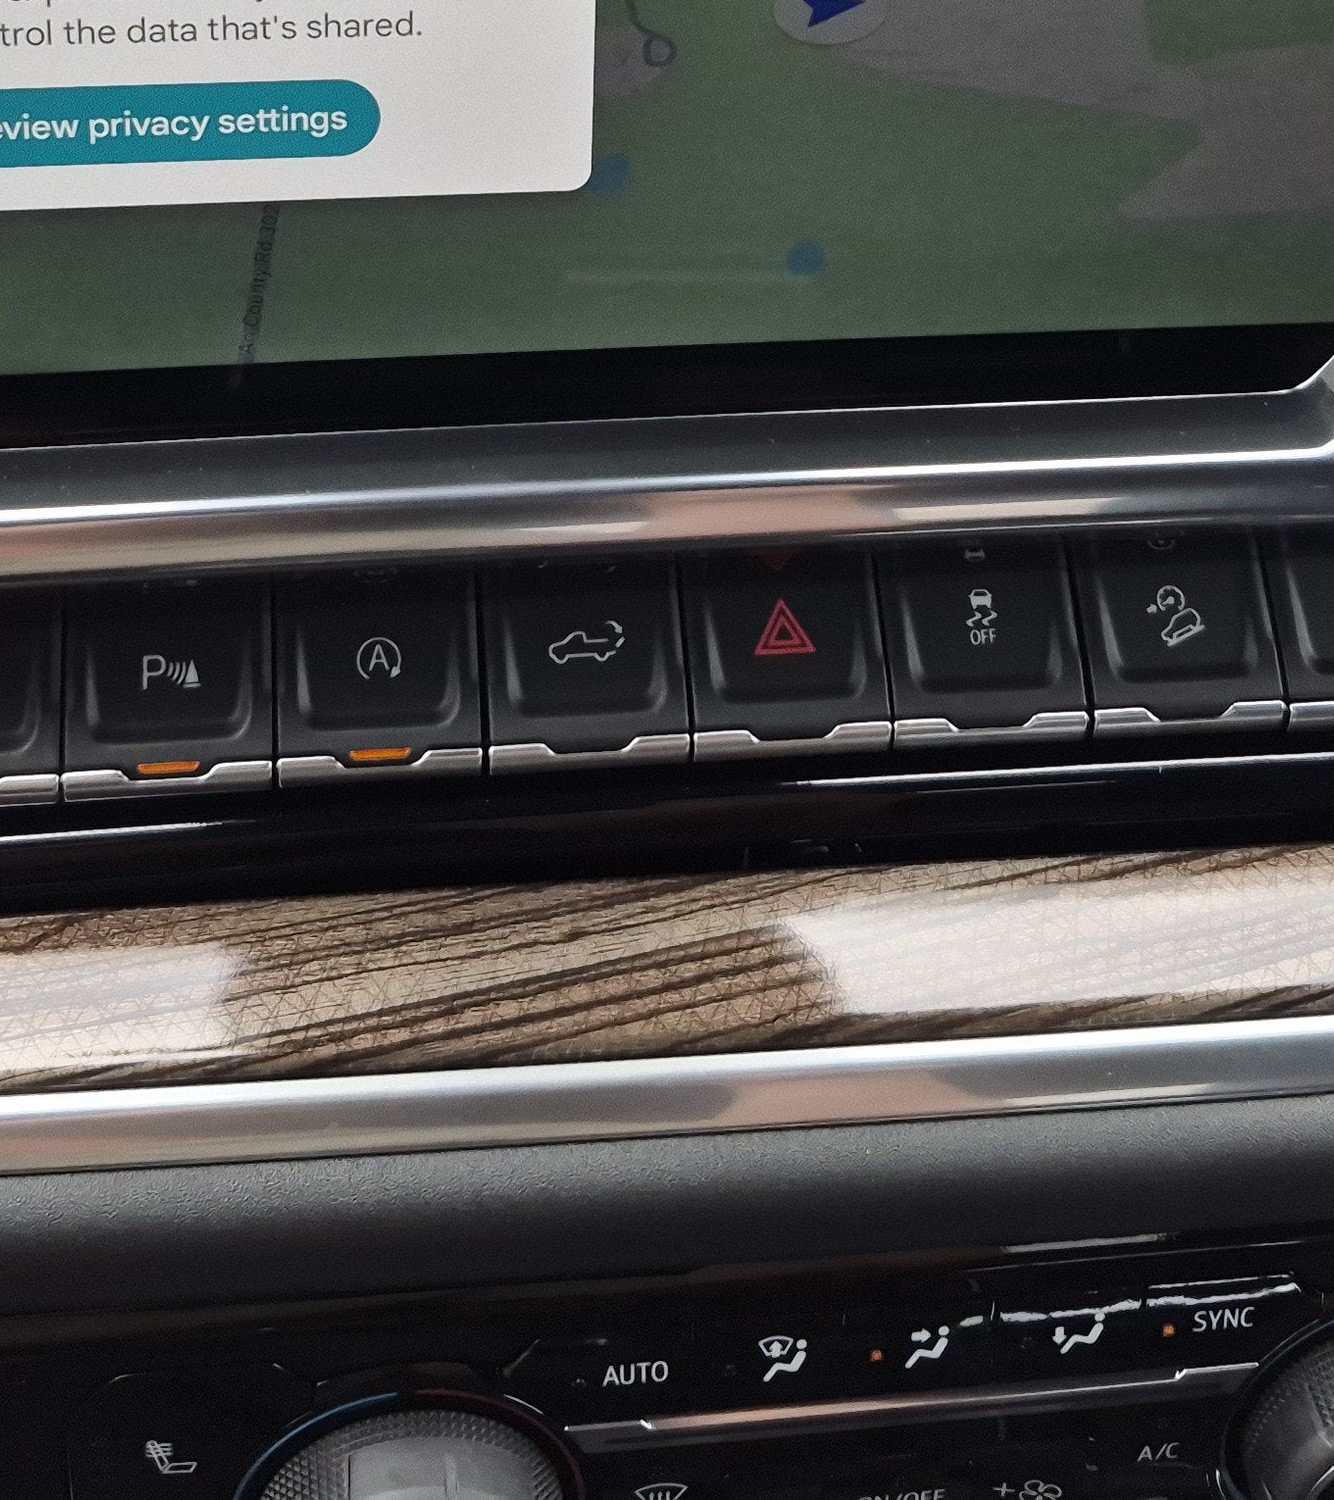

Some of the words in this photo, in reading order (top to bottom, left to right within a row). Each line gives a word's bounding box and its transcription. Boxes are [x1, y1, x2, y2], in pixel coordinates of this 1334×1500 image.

[62, 18, 116, 46] the
[126, 16, 198, 44] data
[207, 14, 297, 42] that's
[306, 10, 422, 40] shared.
[89, 109, 210, 145] privacy
[218, 104, 348, 138] settings
[243, 266, 272, 327] County
[970, 628, 996, 645] OFF
[368, 643, 390, 671] A
[142, 654, 167, 690] P
[1192, 1306, 1255, 1332] SYNC
[602, 1360, 669, 1387] AUTO
[1137, 1442, 1179, 1462] A/C
